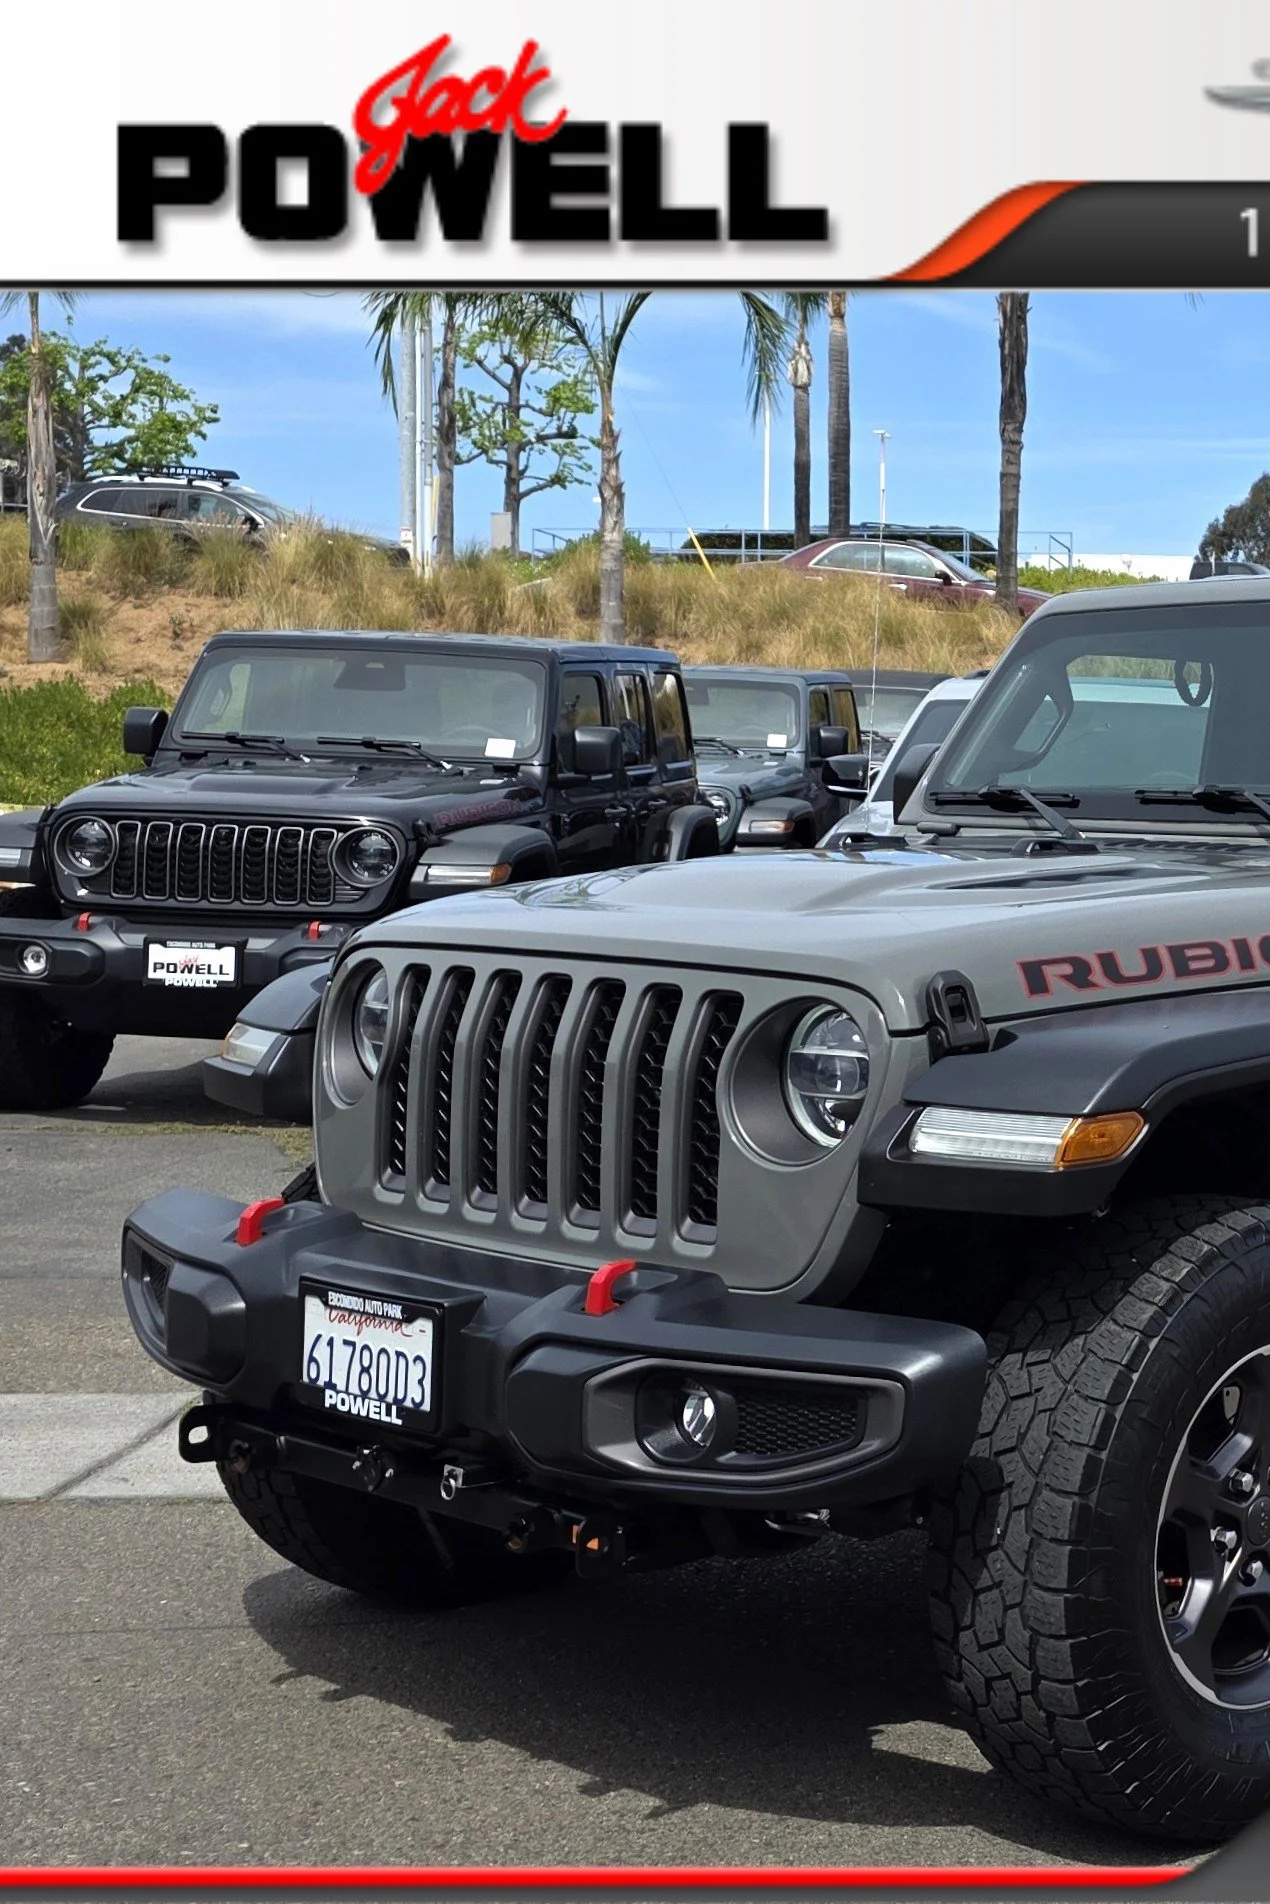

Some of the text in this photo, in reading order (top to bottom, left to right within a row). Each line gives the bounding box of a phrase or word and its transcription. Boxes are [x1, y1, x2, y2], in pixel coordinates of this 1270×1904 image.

[153, 961, 230, 975] POWELL
[164, 977, 218, 988] POWELL
[327, 1291, 403, 1320] ESCONDIDO AUTO PARK
[327, 1308, 413, 1337] California
[306, 1333, 427, 1409] 61780D3
[324, 1388, 403, 1426] POWELL
